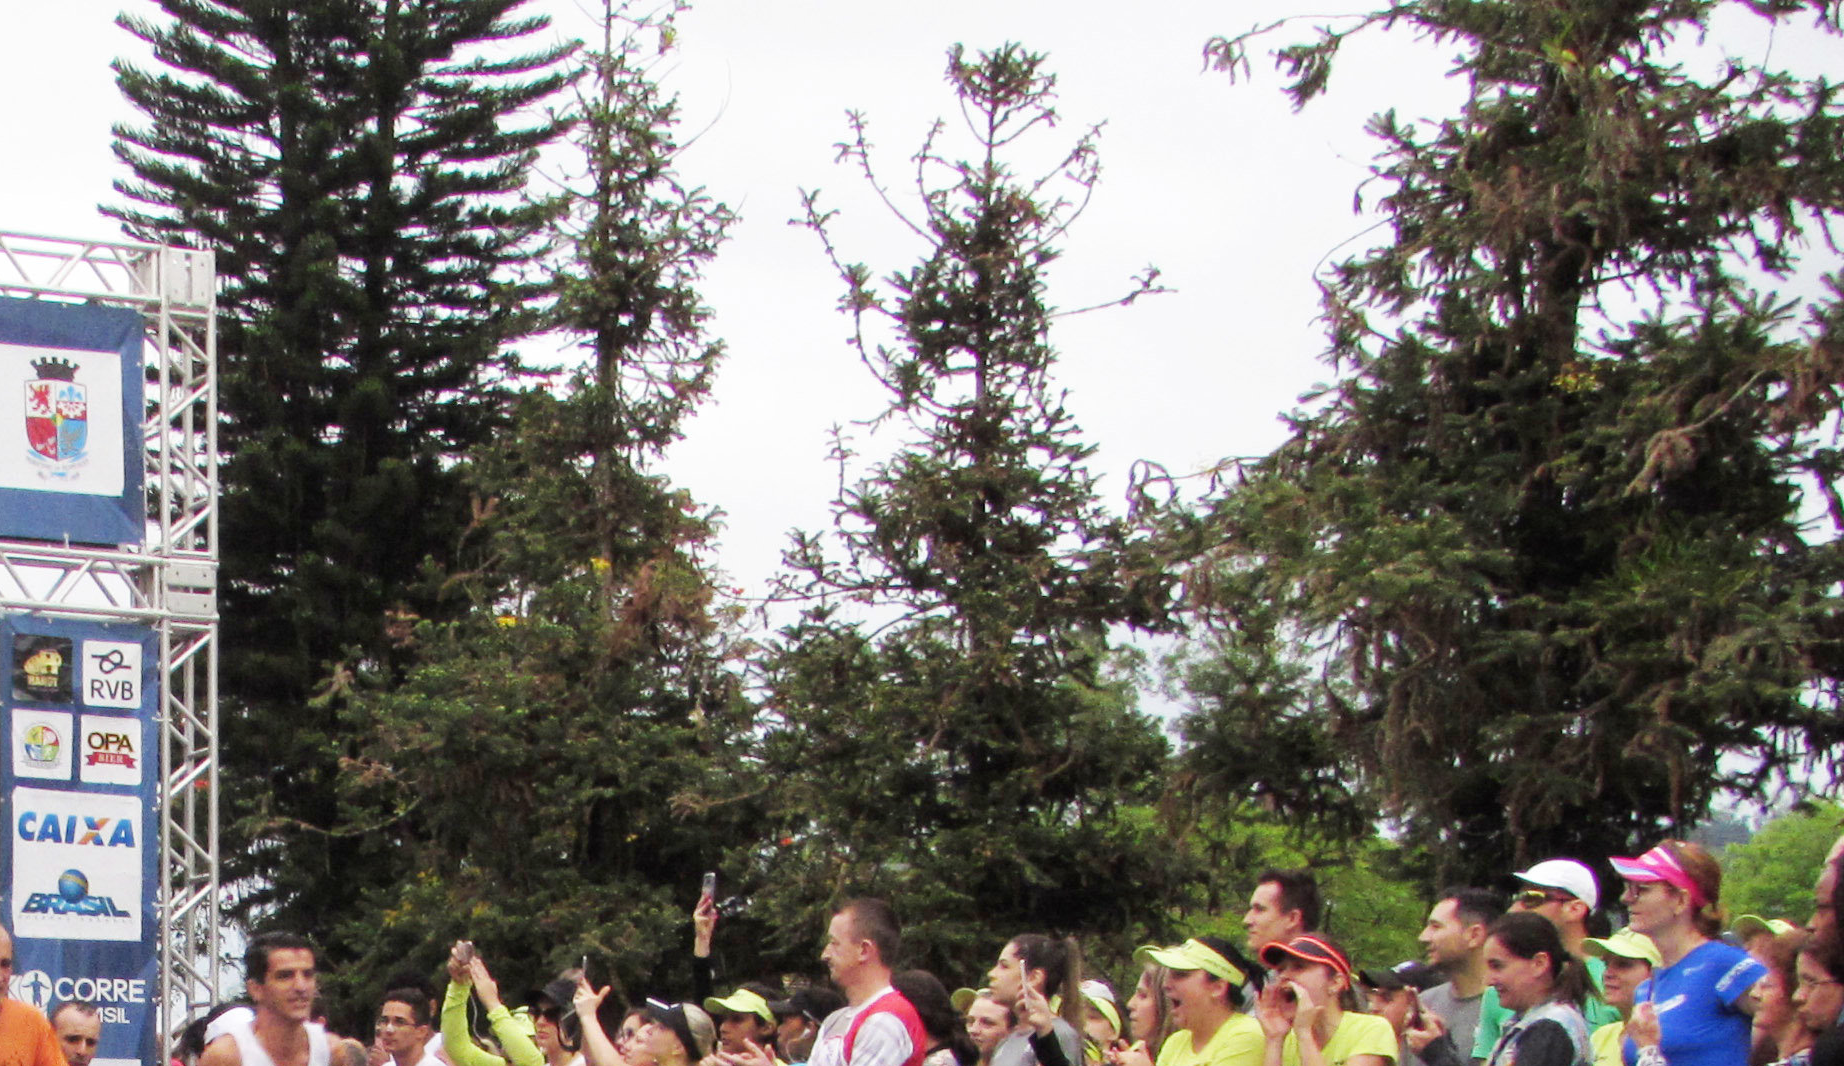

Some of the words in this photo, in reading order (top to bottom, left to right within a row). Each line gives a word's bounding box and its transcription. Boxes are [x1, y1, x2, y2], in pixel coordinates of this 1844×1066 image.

[90, 678, 134, 701] RVB
[87, 732, 134, 753] OPA
[18, 811, 136, 849] CAIXA
[54, 976, 147, 1004] CORRE
